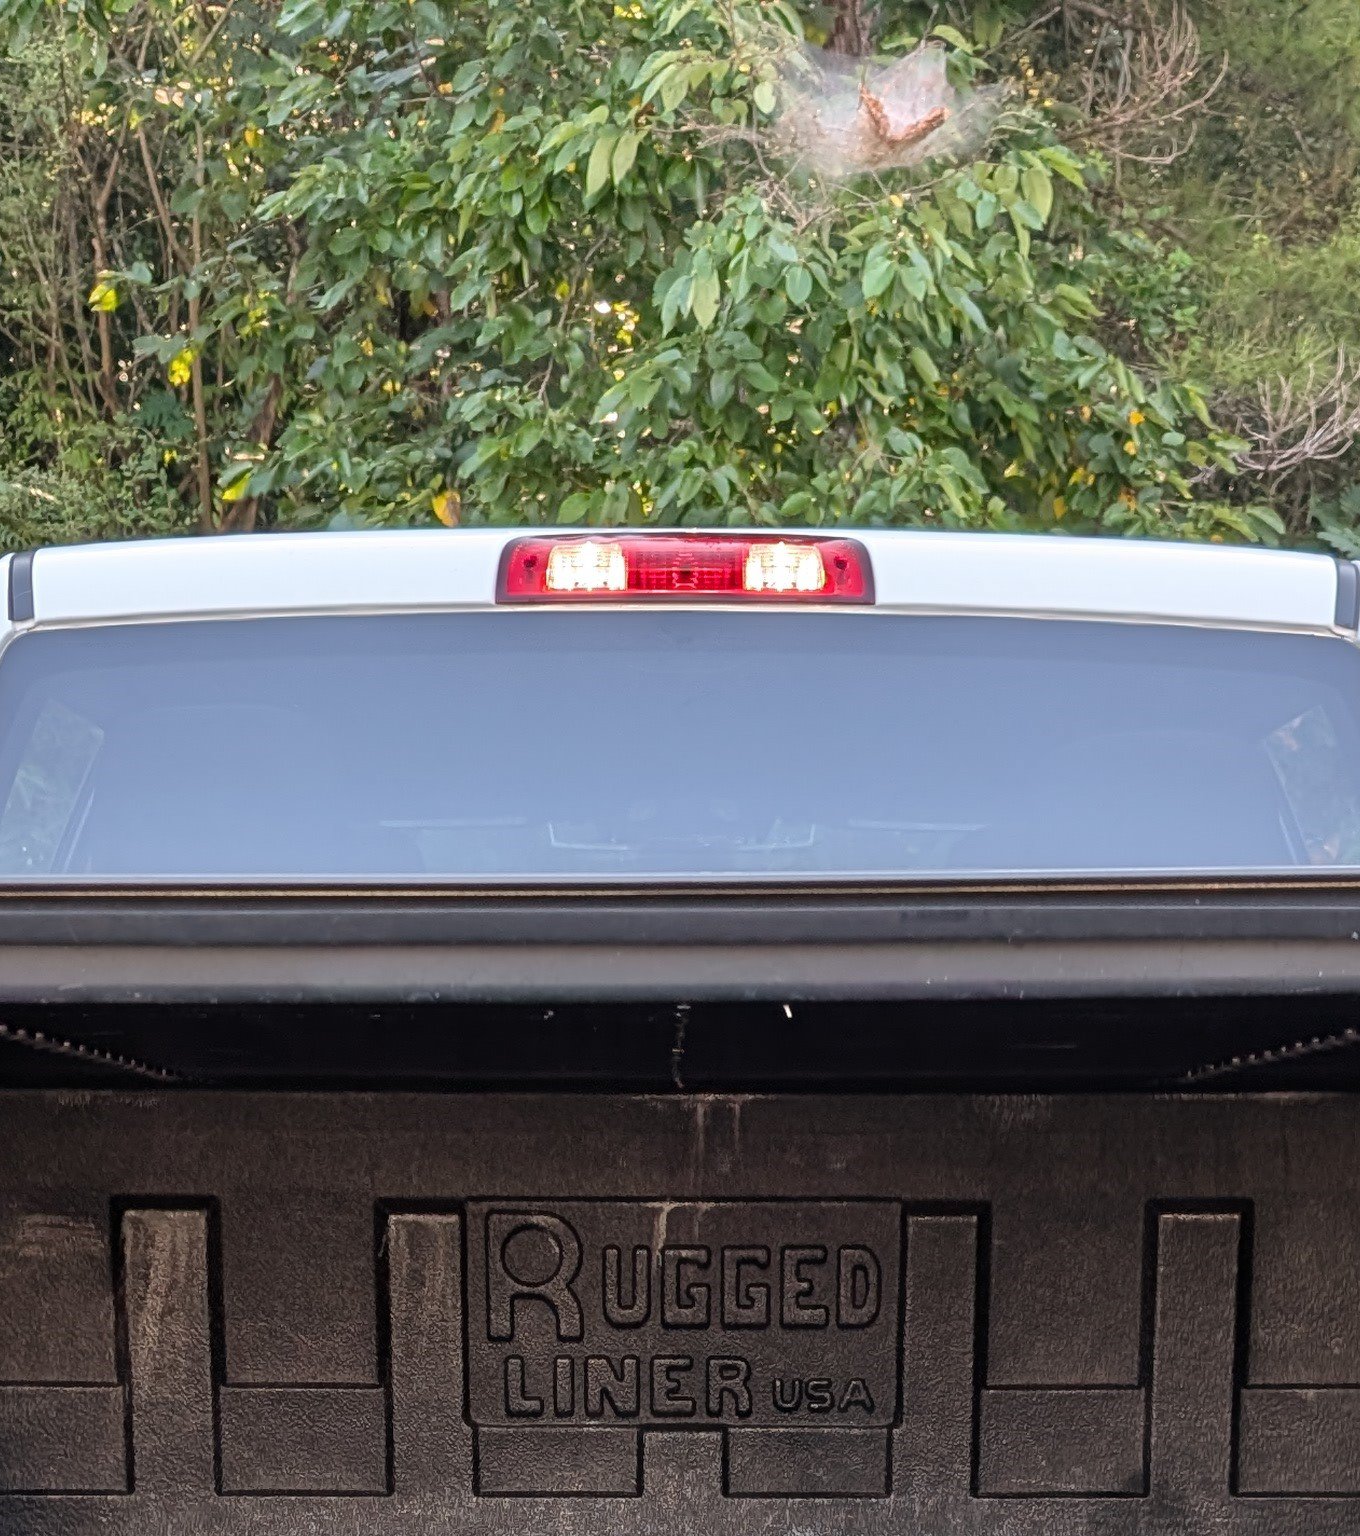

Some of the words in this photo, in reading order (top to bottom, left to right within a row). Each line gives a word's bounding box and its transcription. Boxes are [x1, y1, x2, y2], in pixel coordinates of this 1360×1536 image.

[484, 1209, 882, 1342] RUGGED
[503, 1355, 753, 1418] LINER
[772, 1377, 875, 1415] USA
